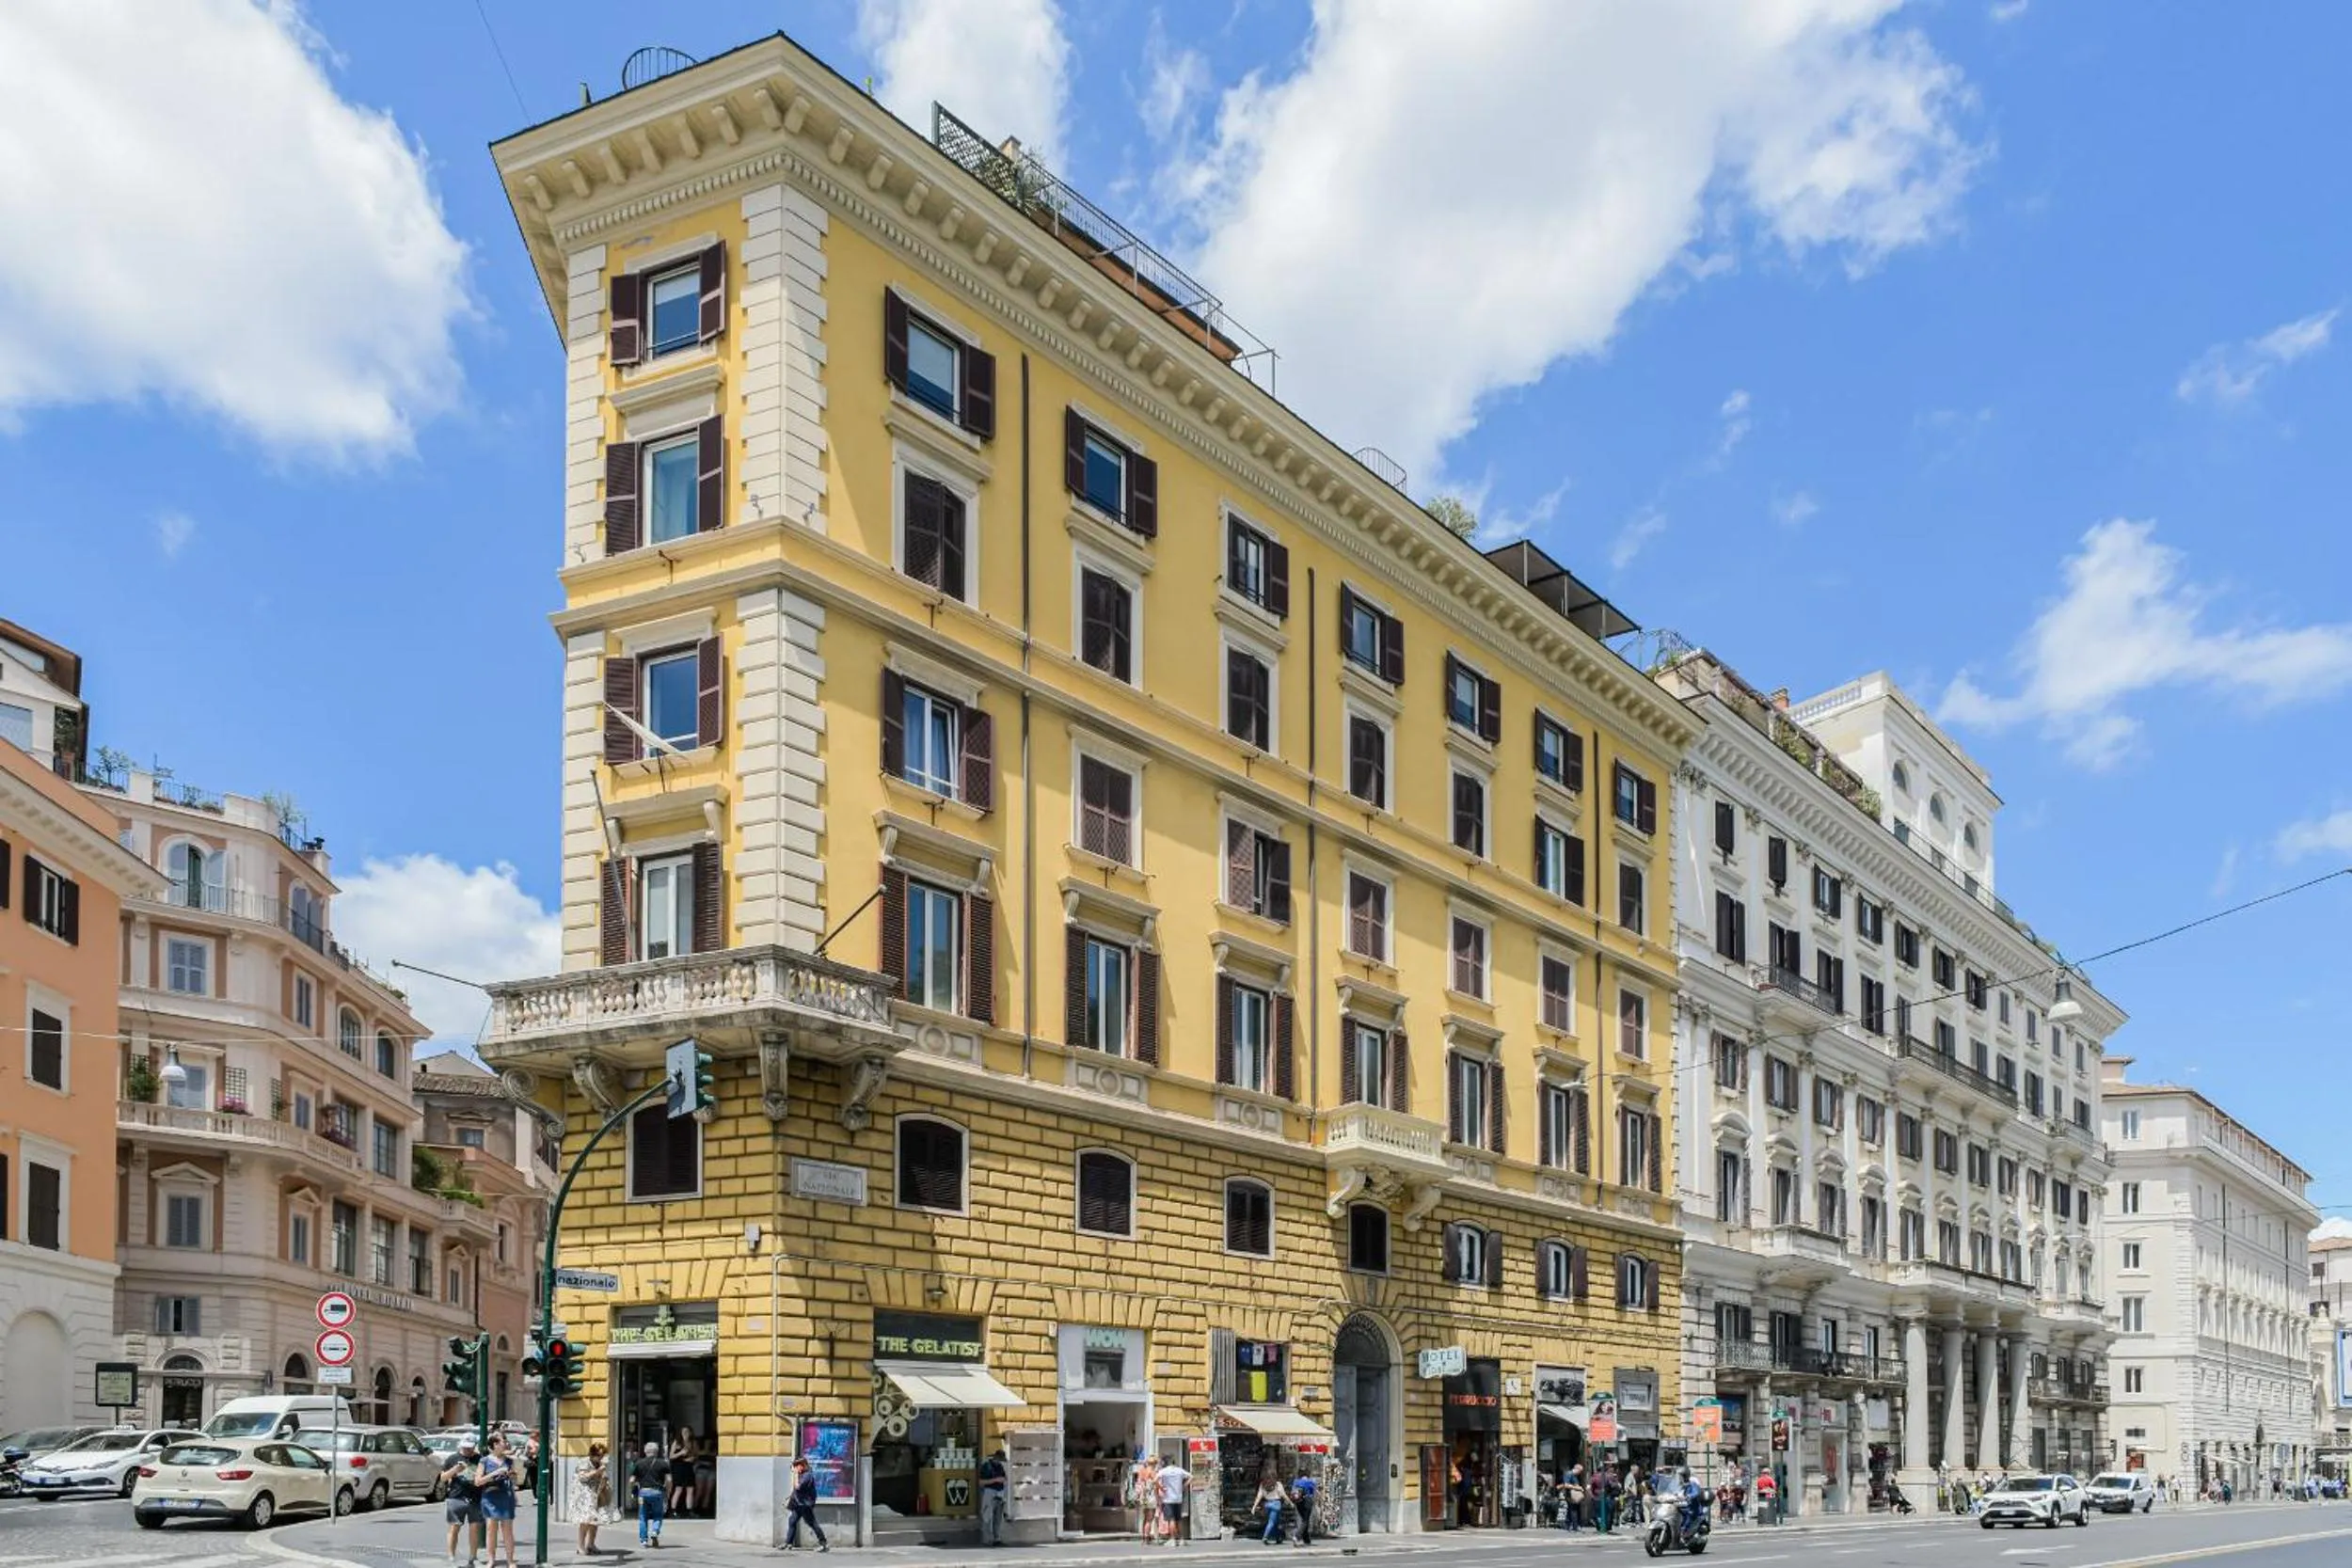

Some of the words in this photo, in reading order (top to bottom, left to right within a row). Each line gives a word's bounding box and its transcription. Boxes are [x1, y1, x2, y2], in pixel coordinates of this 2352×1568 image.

[877, 1337, 908, 1353] THE
[911, 1338, 982, 1356] GELATIST
[1422, 1350, 1458, 1363] HOTEL
